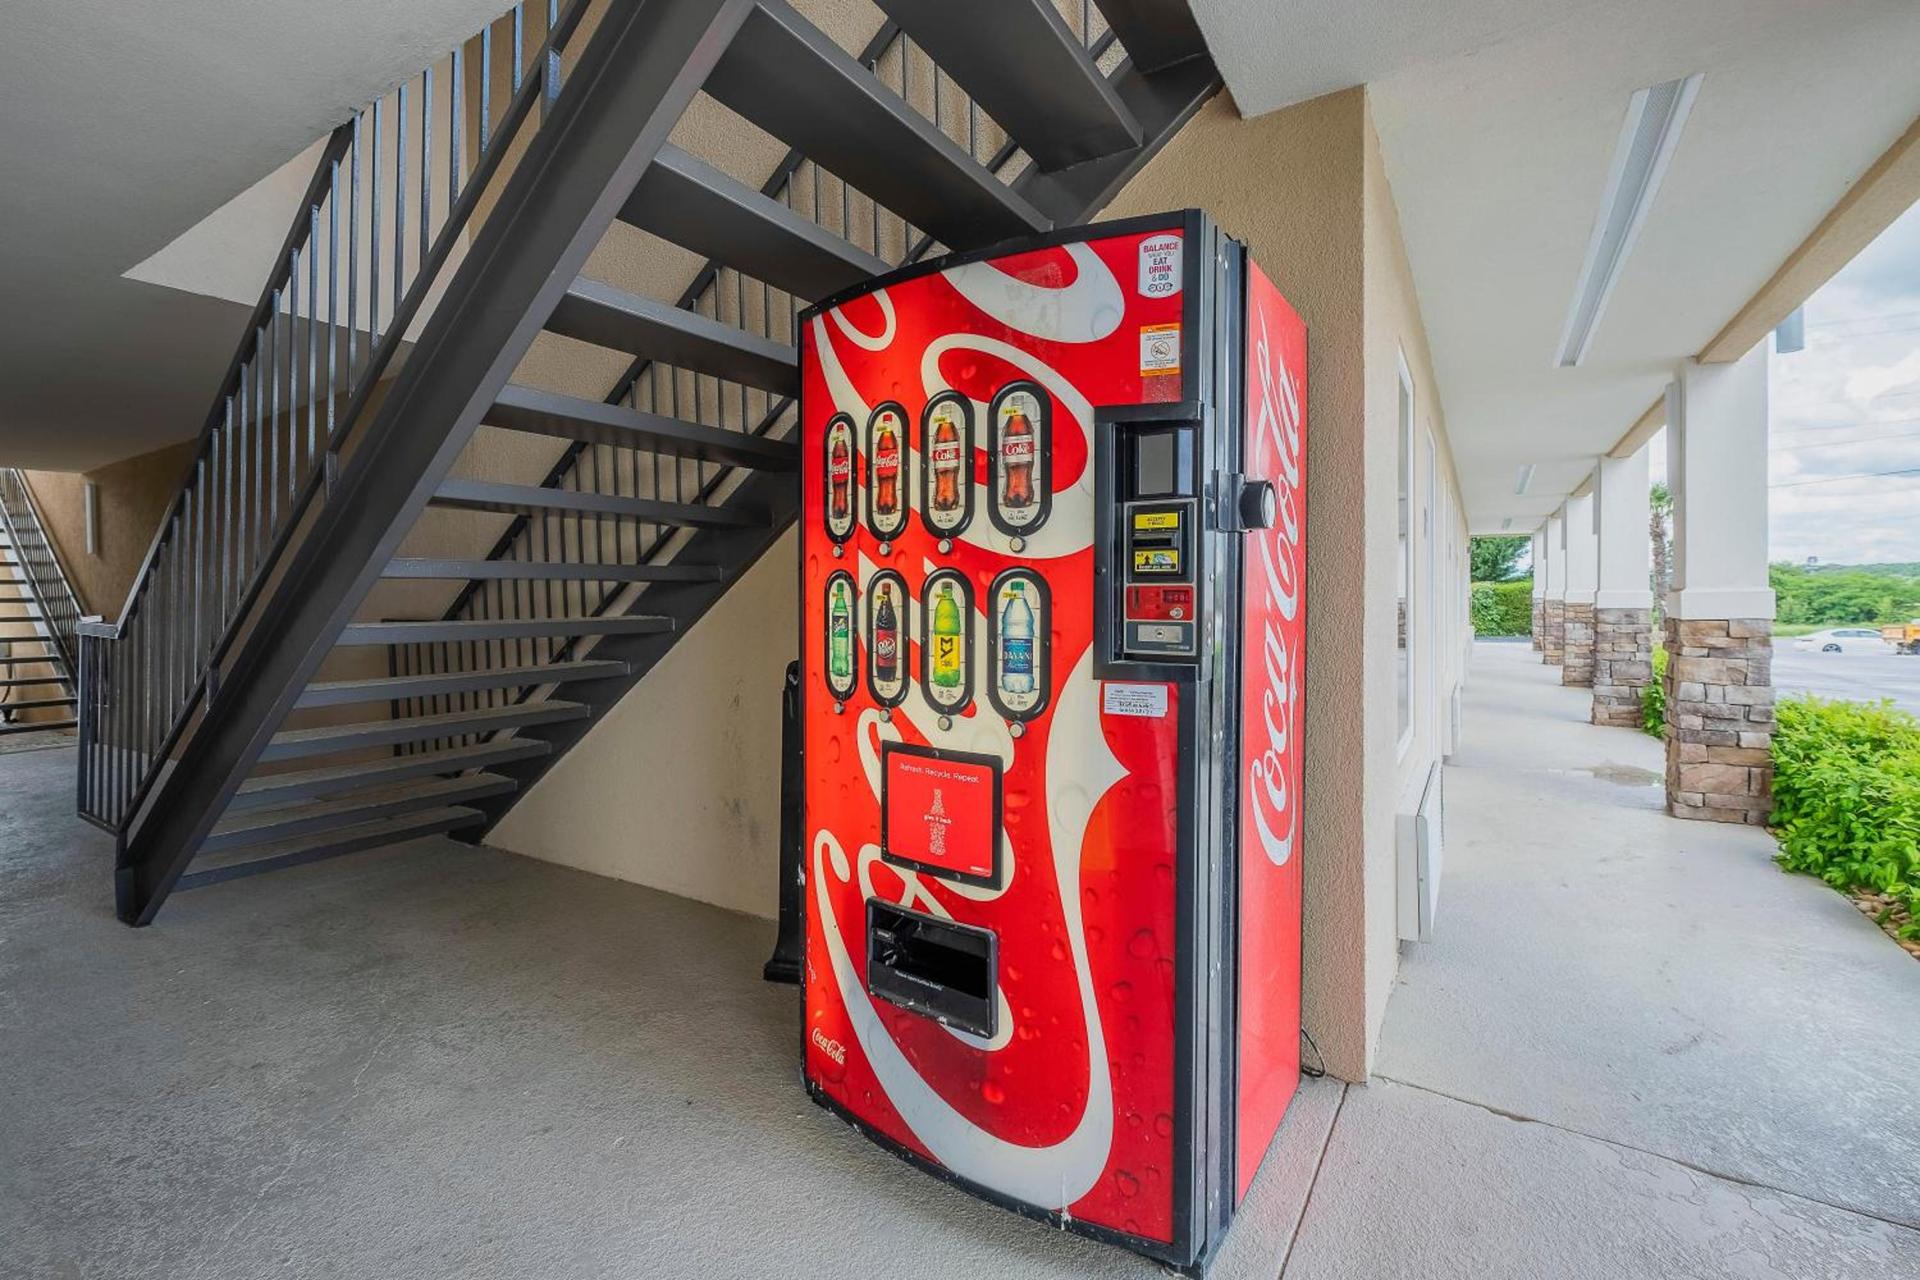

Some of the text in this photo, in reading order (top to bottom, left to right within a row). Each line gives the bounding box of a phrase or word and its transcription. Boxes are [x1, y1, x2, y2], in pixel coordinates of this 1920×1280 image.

[1143, 241, 1179, 253] BALANCE
[1153, 257, 1168, 265] EAT
[1149, 264, 1173, 274] DRINK
[1158, 272, 1169, 281] DO
[1005, 442, 1031, 455] Coke
[925, 767, 952, 779] Recycle.
